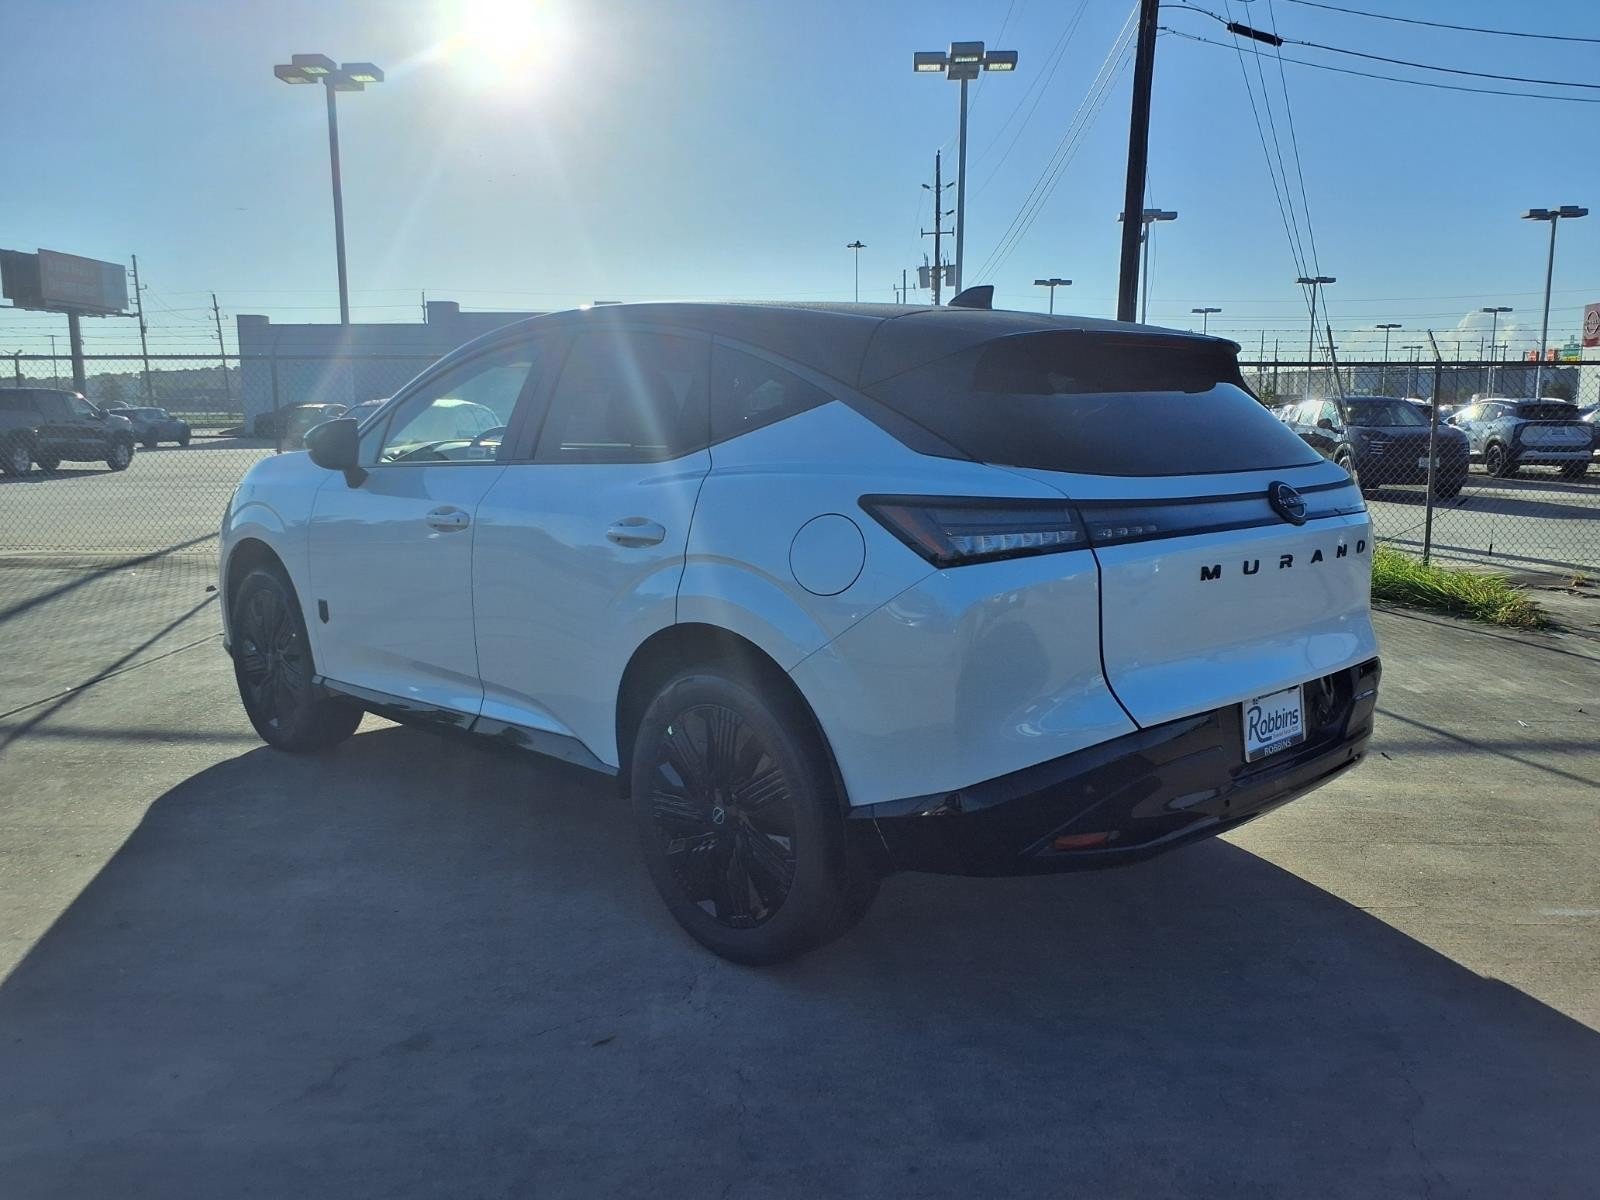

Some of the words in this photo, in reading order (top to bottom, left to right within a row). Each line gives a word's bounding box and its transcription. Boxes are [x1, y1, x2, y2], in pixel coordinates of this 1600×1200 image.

[1200, 540, 1366, 581] MURANO
[1247, 705, 1299, 743] Robbins
[1264, 738, 1292, 756] ROBBINS
